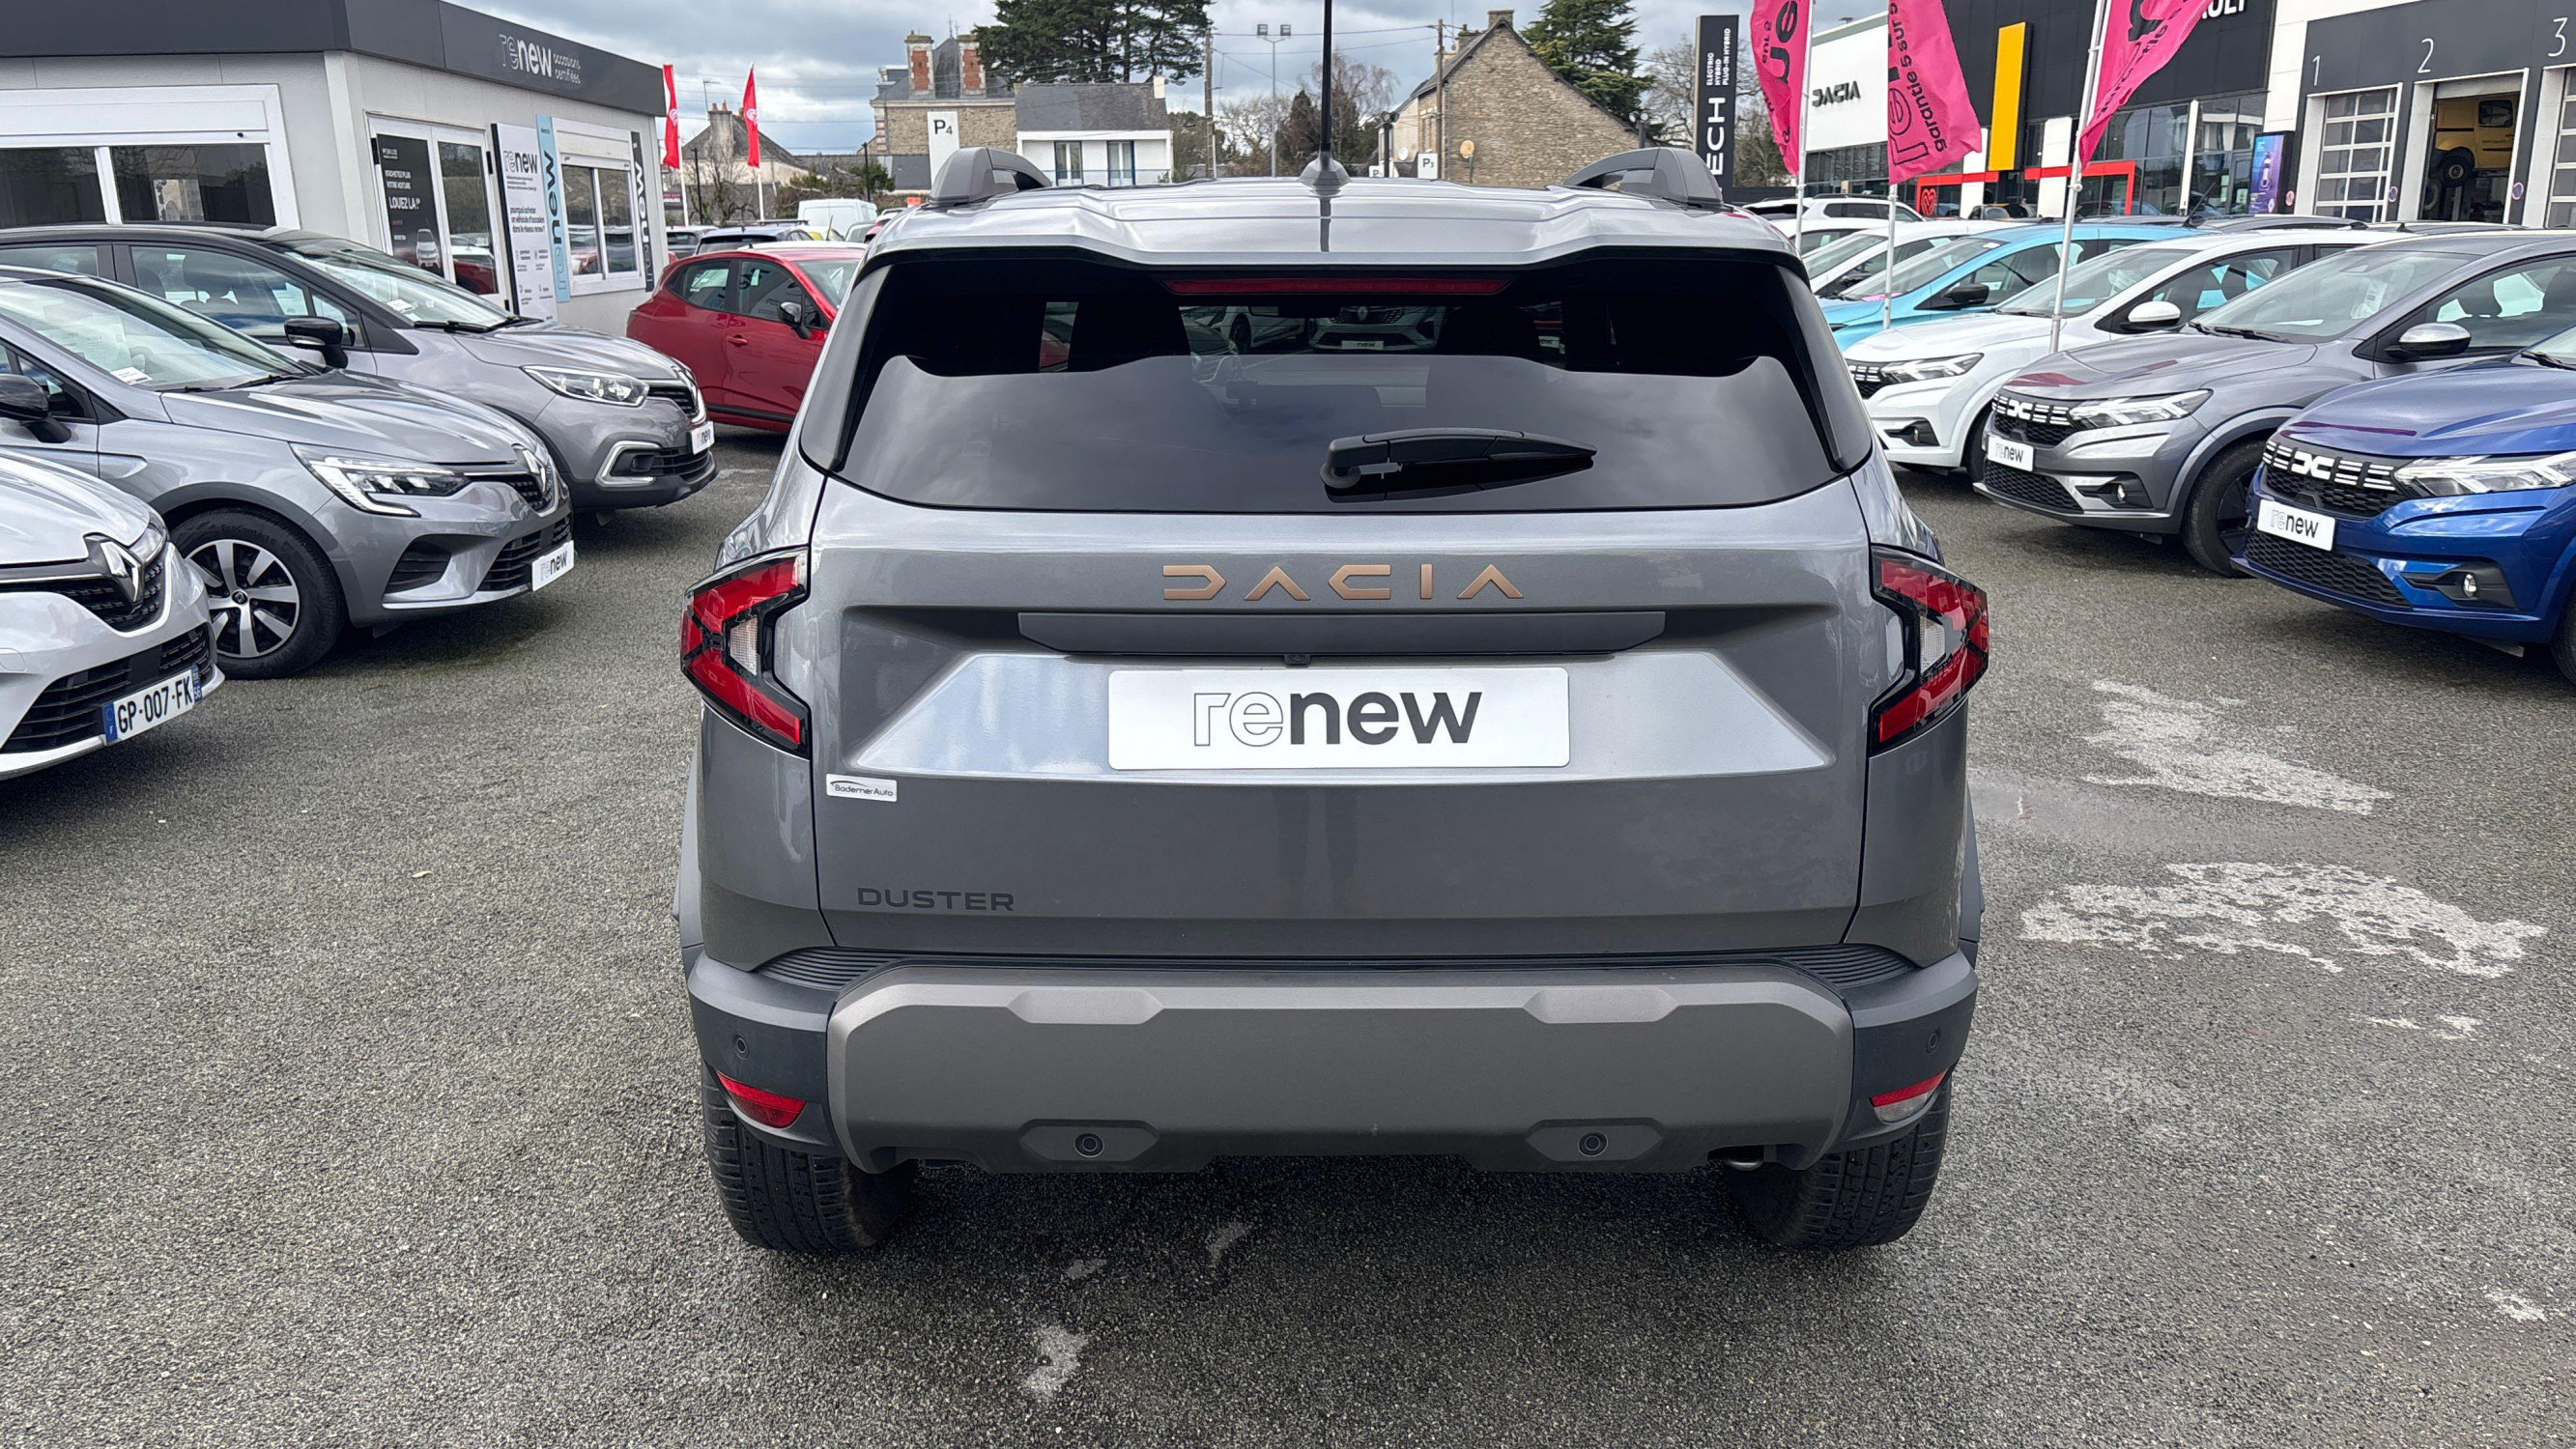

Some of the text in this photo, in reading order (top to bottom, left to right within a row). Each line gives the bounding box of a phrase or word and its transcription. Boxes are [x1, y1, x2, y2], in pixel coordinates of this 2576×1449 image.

[1891, 20, 1908, 53] sur
[2547, 17, 2569, 58] 3
[499, 34, 553, 78] renew
[1706, 52, 1715, 86] ELECTRIC
[1722, 28, 1732, 86] PLUG-IN HYBRID
[1900, 55, 1913, 68] 5
[2312, 55, 2321, 87] 1
[2417, 38, 2435, 74] 2
[1812, 81, 1861, 108] DACIA
[933, 120, 953, 134] P4
[1906, 71, 1948, 154] garantie
[502, 150, 538, 175] renew
[388, 196, 409, 210] LOUEZ
[544, 150, 567, 290] renew
[635, 161, 654, 282] renew
[2271, 509, 2319, 539] renew
[541, 551, 568, 582] renew
[1162, 563, 1524, 602] DACIA
[117, 675, 192, 734] GP-007-FK
[1193, 691, 1483, 748] renew
[834, 783, 894, 797] Bodemer Auto
[857, 887, 1015, 912] DUSTER
